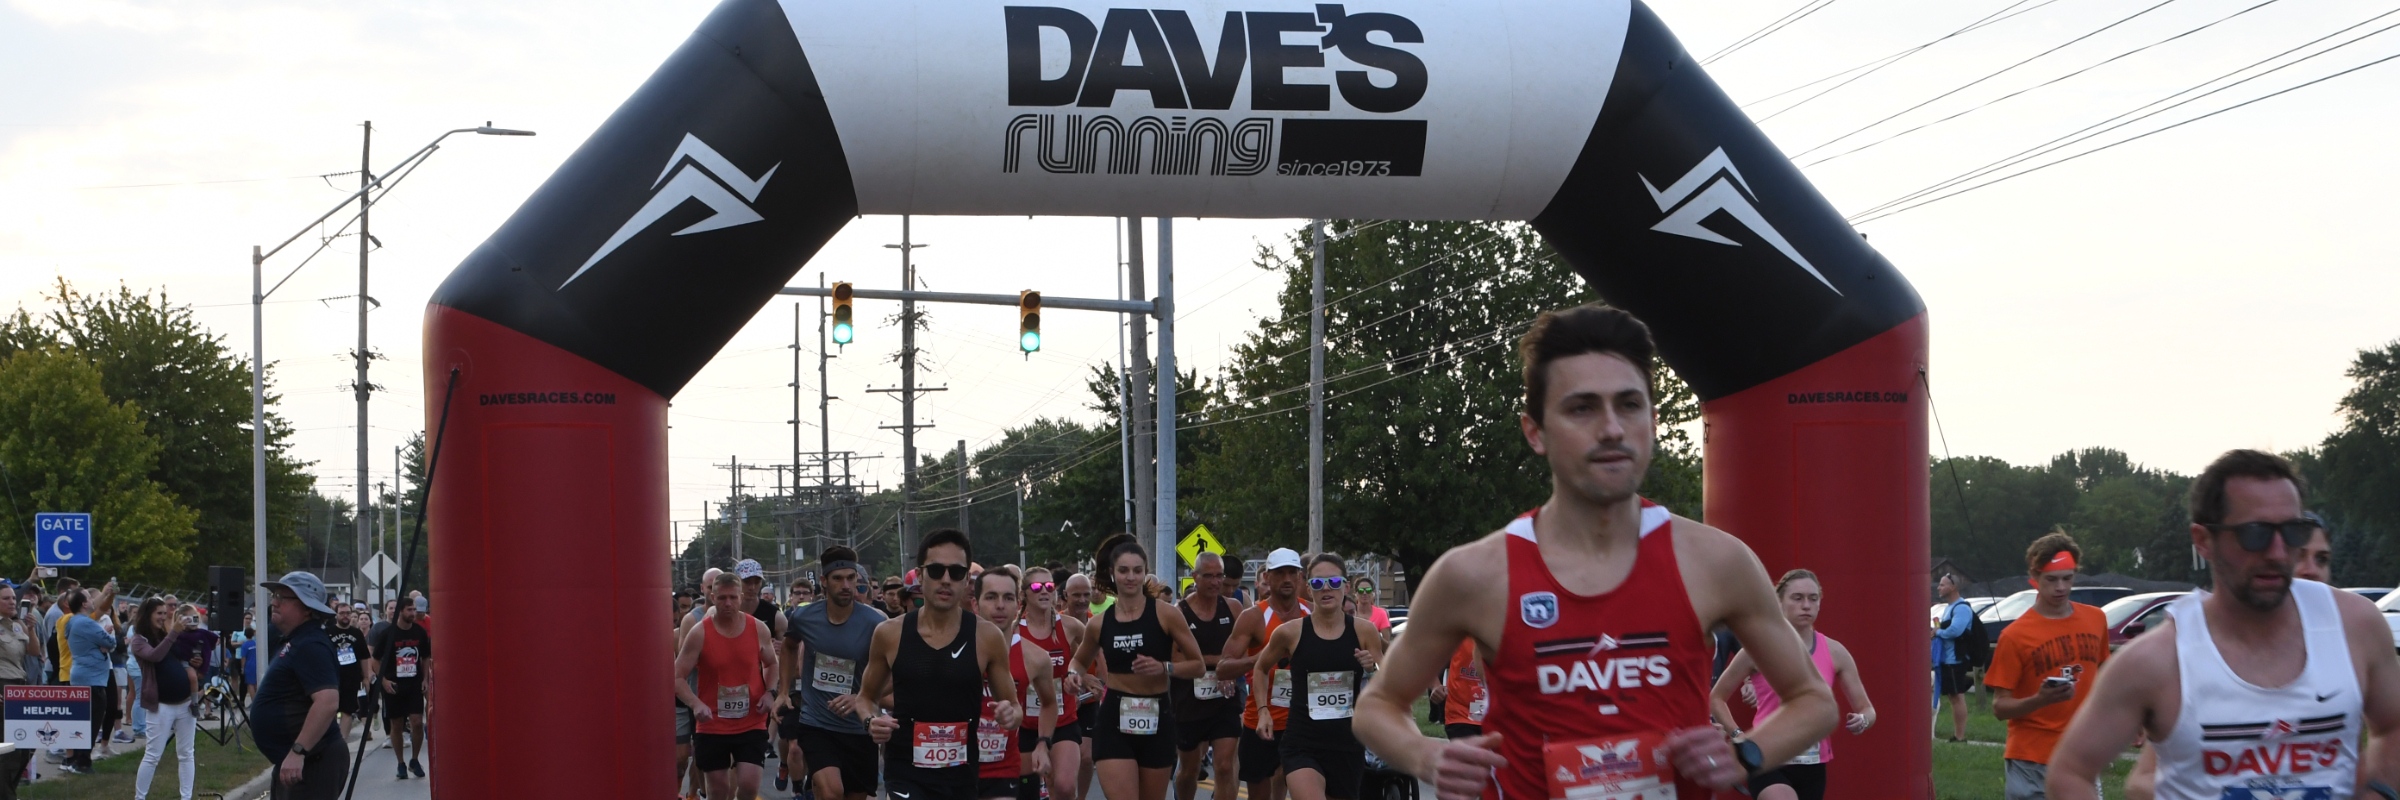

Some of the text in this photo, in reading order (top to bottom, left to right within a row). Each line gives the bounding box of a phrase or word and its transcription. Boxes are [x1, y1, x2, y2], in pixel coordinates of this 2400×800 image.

[1003, 3, 1429, 113] DAVE'S
[1003, 113, 1274, 177] running
[479, 391, 616, 406] DAVESRACES.COM
[1787, 391, 1908, 405] DAVESRACES.COM
[41, 518, 85, 531] GATE
[53, 535, 74, 561] C
[1113, 639, 1144, 649] DAVE'S
[2031, 633, 2076, 677] BOWLING
[820, 671, 846, 684] 920
[1537, 654, 1673, 695] DAVE'S
[7, 689, 89, 699] BOY SCOUTS ARE
[1279, 687, 1292, 697] 78
[724, 701, 744, 710] 879
[1317, 693, 1347, 706] 905
[23, 706, 72, 715] HELPFUL
[1128, 718, 1151, 729] 901
[924, 748, 958, 762] 403
[2202, 738, 2342, 777] DAVE'S
